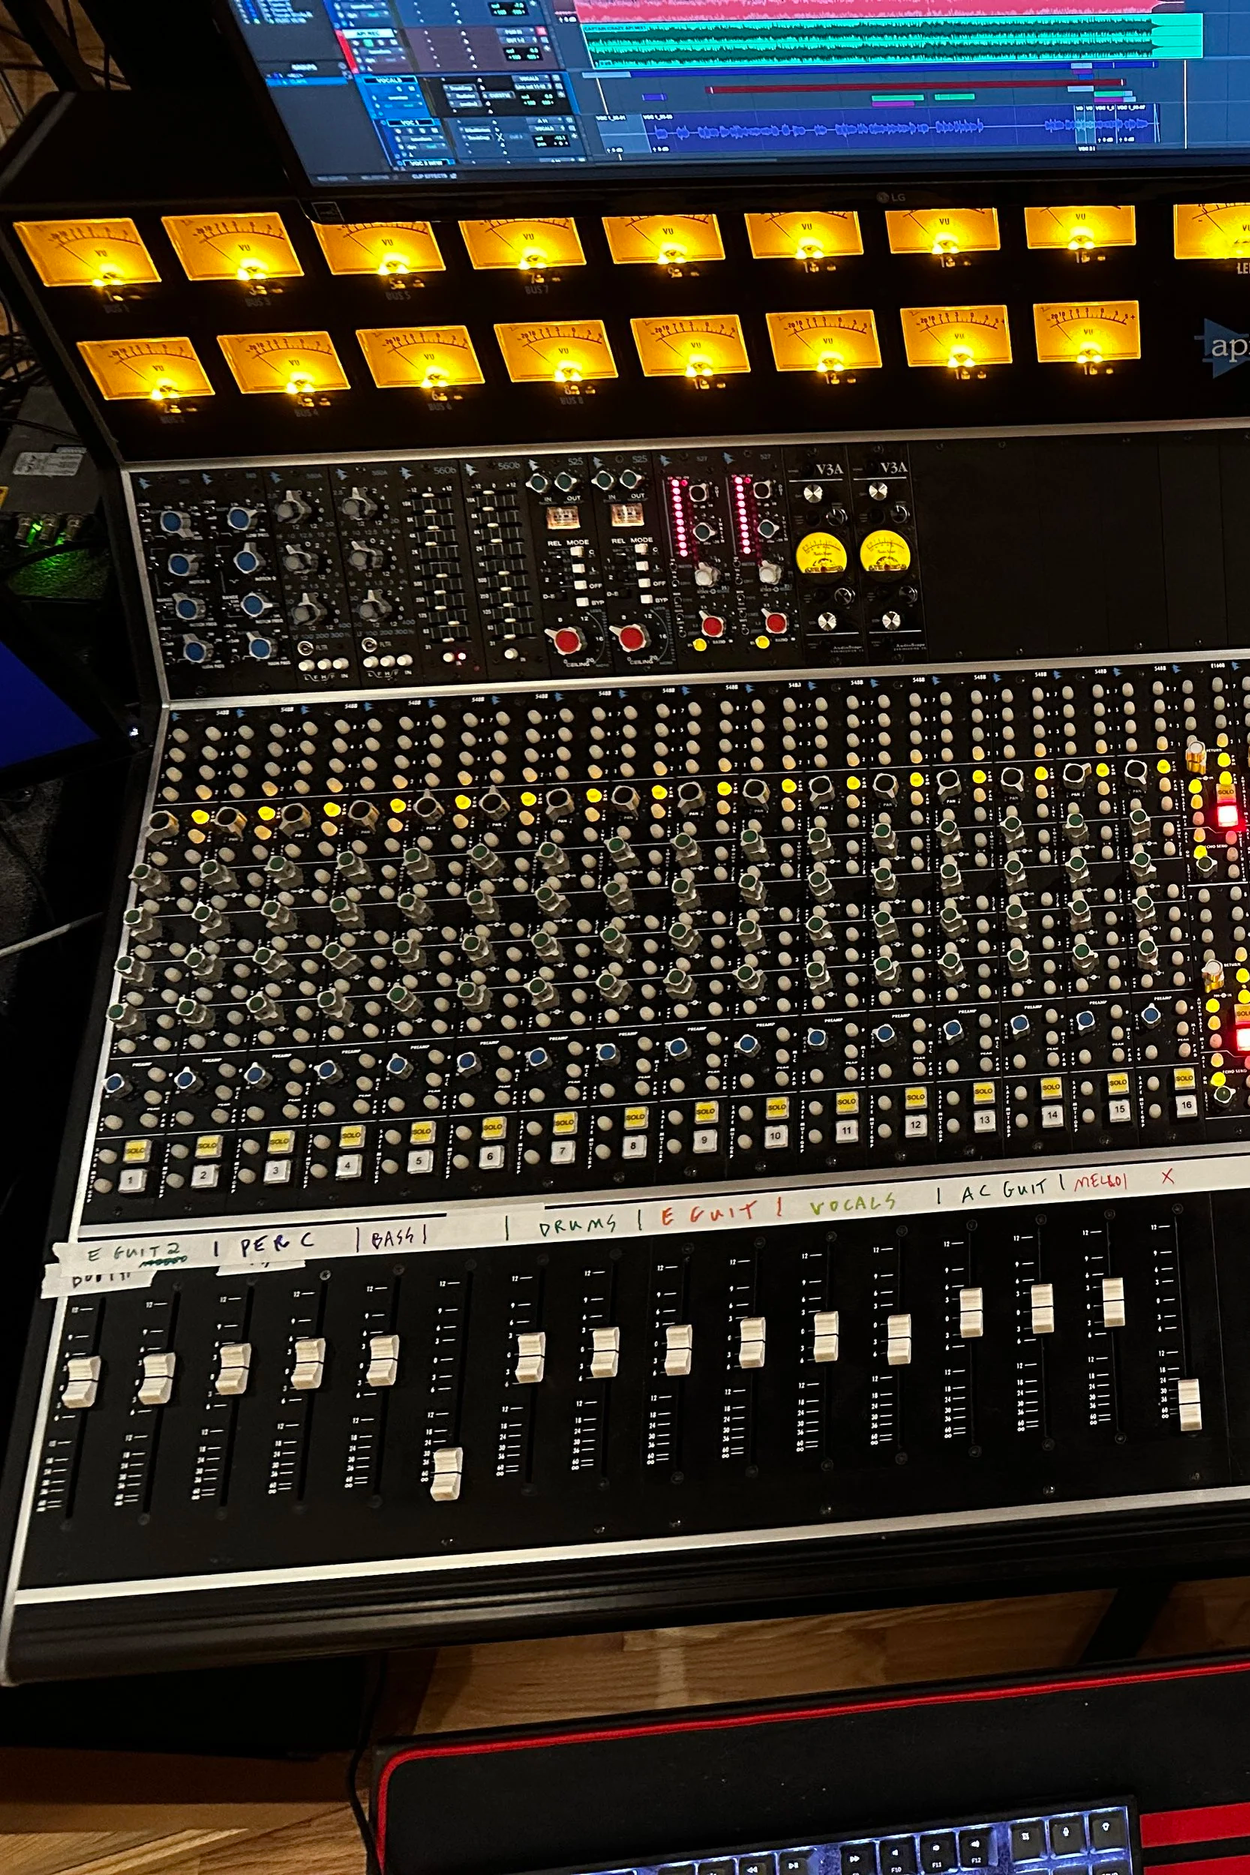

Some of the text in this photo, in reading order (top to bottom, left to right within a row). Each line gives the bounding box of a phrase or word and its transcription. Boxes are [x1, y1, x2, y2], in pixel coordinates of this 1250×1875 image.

[816, 463, 844, 475] V3A
[881, 461, 908, 473] V3A
[1108, 1078, 1127, 1087] SOLO
[1176, 1074, 1194, 1083] SOLO
[1041, 1082, 1061, 1091] SOLO
[975, 1087, 993, 1096] SOLO
[837, 1097, 856, 1106] SOLO
[907, 1093, 925, 1101] SOLO
[696, 1107, 715, 1116] SOLO
[767, 1103, 786, 1112] SOLO
[626, 1113, 646, 1122] SOLO
[554, 1118, 573, 1127] SOLO
[412, 1127, 432, 1136] SOLO
[483, 1123, 503, 1132] SOLO
[342, 1131, 361, 1140] SOLO
[198, 1142, 217, 1150] SOLO
[270, 1137, 289, 1146] SOLO
[126, 1147, 146, 1155] SOLO
[1162, 1167, 1174, 1184] X
[961, 1177, 1047, 1203] AC GUIT
[809, 1191, 896, 1217] VOCALS
[661, 1198, 759, 1226] E GUIT
[539, 1214, 616, 1237] DRUMS
[88, 1248, 103, 1261] E
